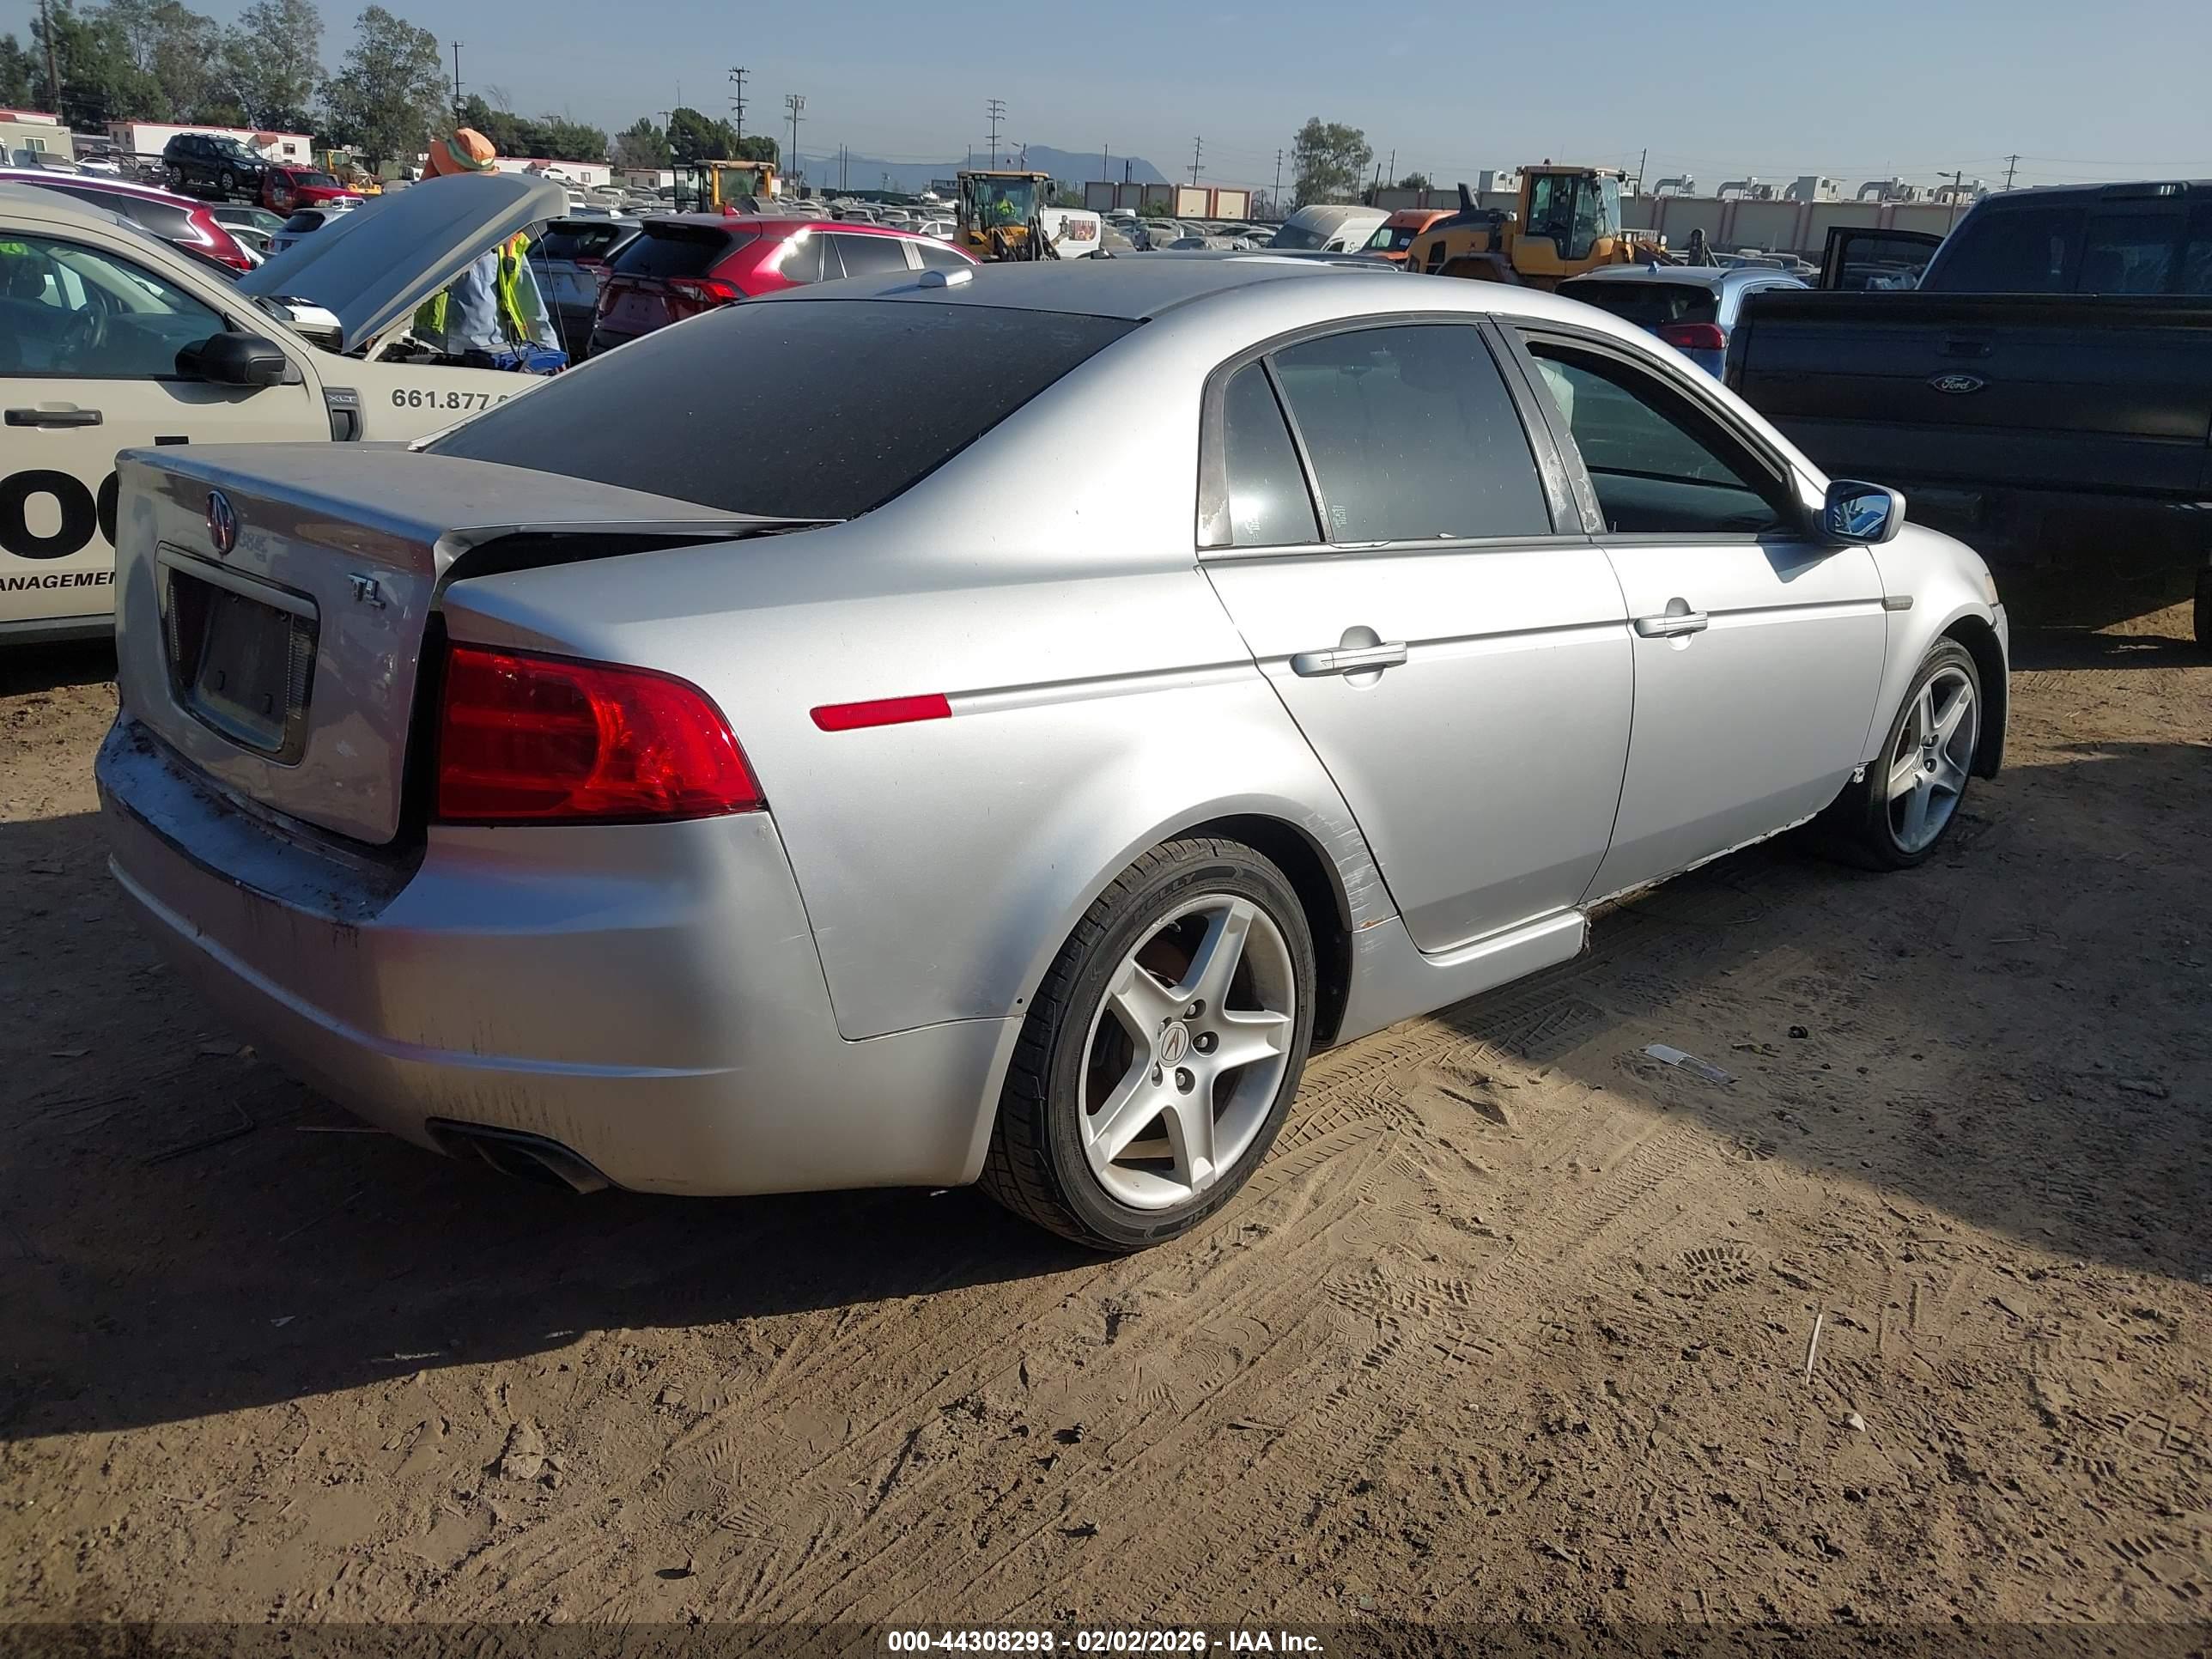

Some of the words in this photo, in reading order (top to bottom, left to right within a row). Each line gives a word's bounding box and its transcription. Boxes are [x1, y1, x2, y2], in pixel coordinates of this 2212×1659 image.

[328, 394, 357, 404] XLT
[347, 572, 386, 609] TL
[1133, 872, 1196, 924] KELLY
